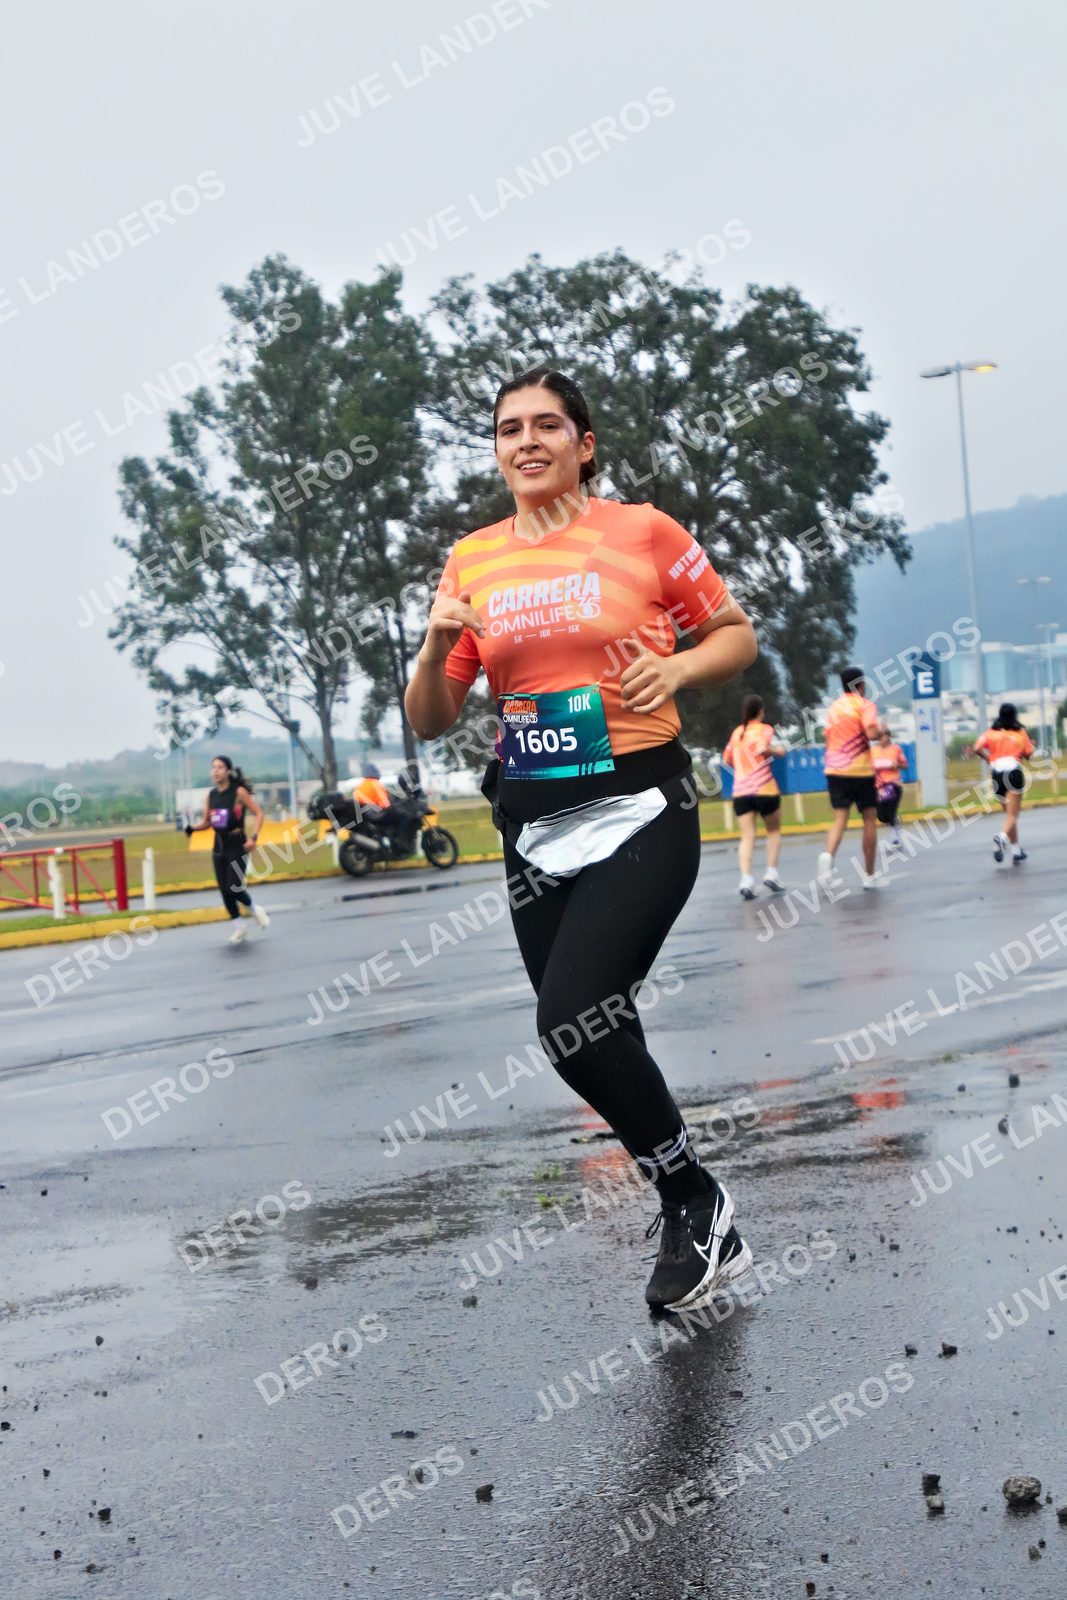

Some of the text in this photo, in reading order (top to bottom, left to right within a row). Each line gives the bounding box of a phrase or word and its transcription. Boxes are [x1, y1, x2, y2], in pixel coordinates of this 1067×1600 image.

[489, 572, 600, 617] CARRERA
[490, 605, 576, 637] OMNILIFE
[539, 629, 551, 638] 10K
[917, 671, 934, 694] E
[567, 693, 591, 714] 10K
[515, 727, 578, 753] 1605
